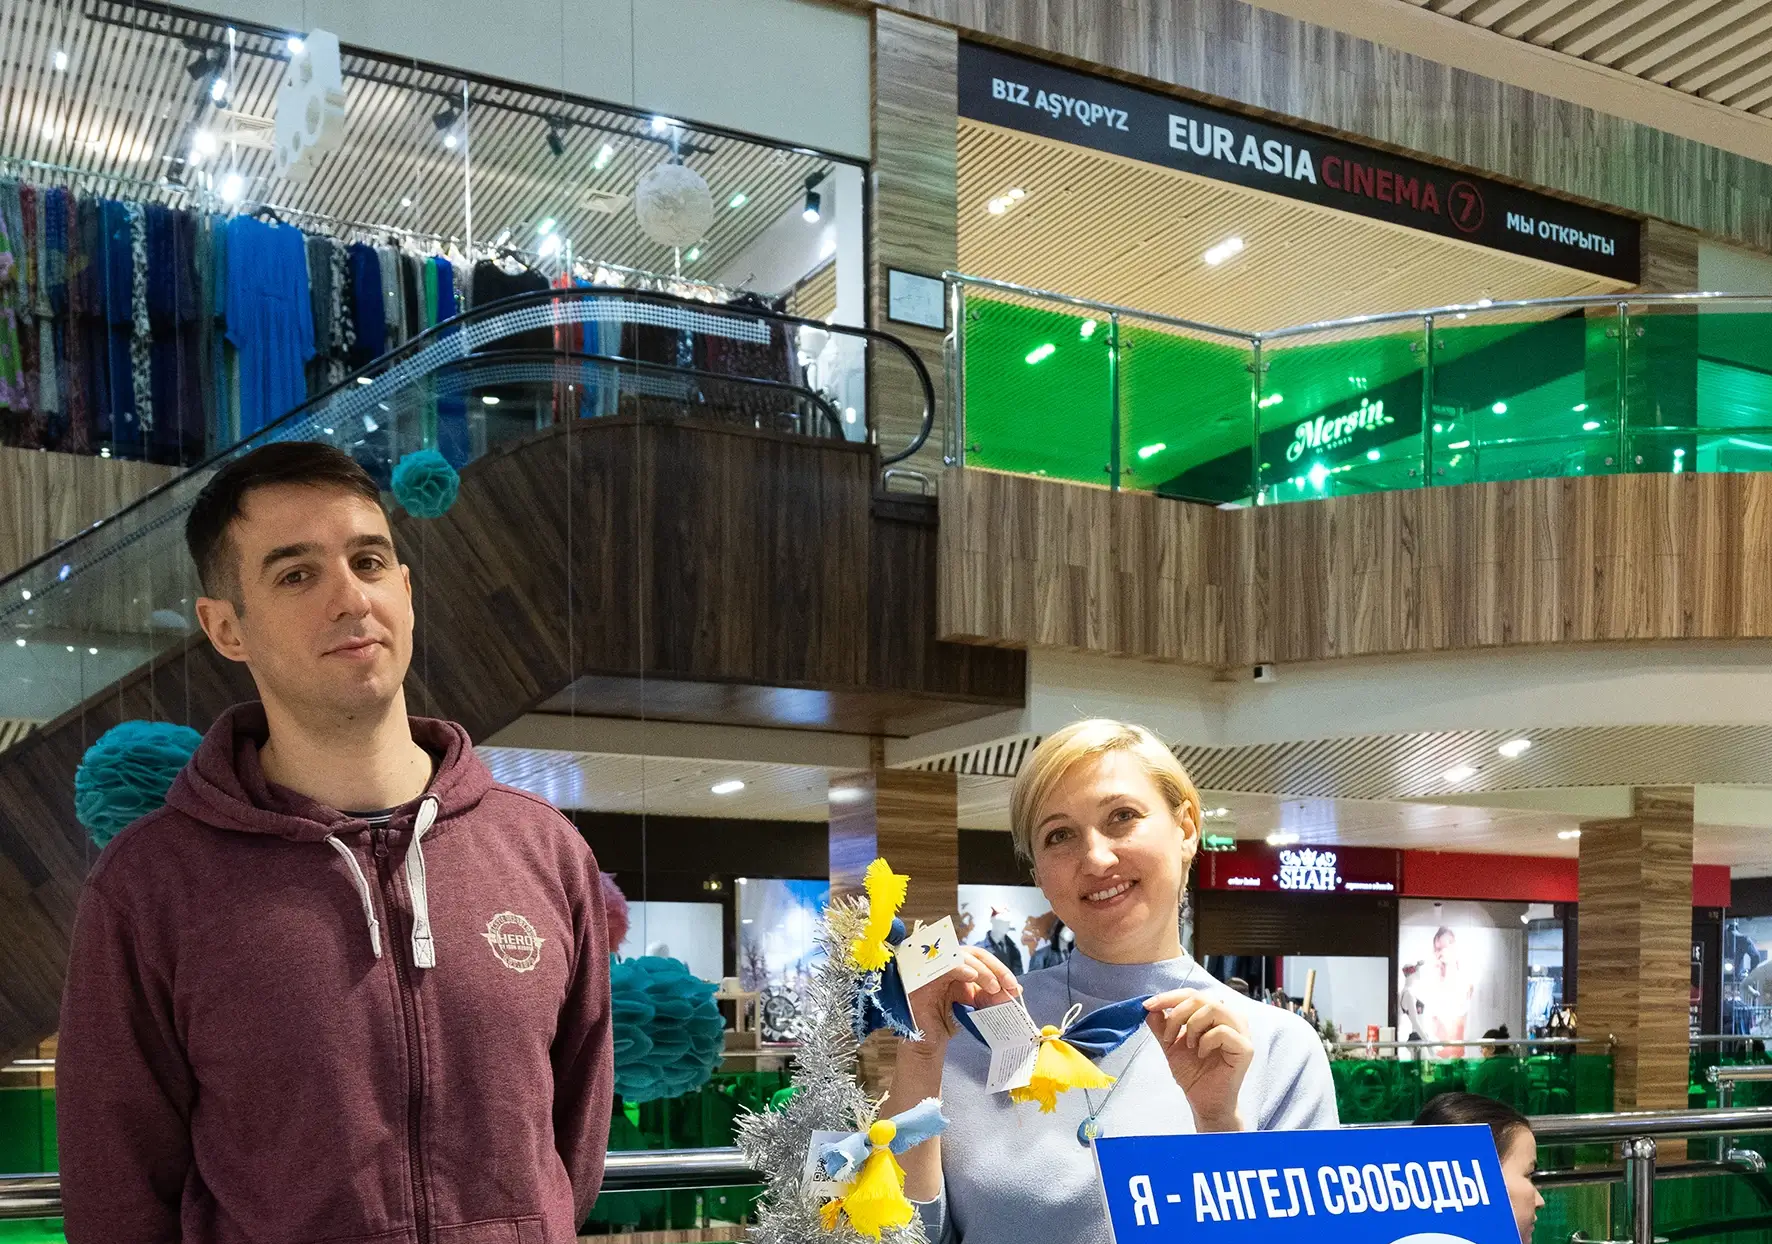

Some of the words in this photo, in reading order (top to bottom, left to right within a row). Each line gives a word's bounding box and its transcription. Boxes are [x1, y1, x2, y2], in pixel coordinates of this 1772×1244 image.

[992, 77, 1030, 107] BIZ
[1034, 88, 1130, 132] AŞYQPYZ
[1168, 114, 1317, 184] EURASIA
[1320, 155, 1440, 215] CINEMA
[1457, 190, 1475, 222] 7
[1506, 211, 1534, 236] МЫ
[1538, 220, 1615, 256] ОТКРЫТЫ
[1286, 397, 1384, 462] Mersin
[1279, 868, 1336, 891] SHAH
[499, 933, 533, 946] HERO
[1129, 1174, 1159, 1226] Я
[1166, 1193, 1181, 1204] -
[1194, 1166, 1316, 1223] АНГЕЛ
[1317, 1159, 1491, 1217] СВОБОДЫ
